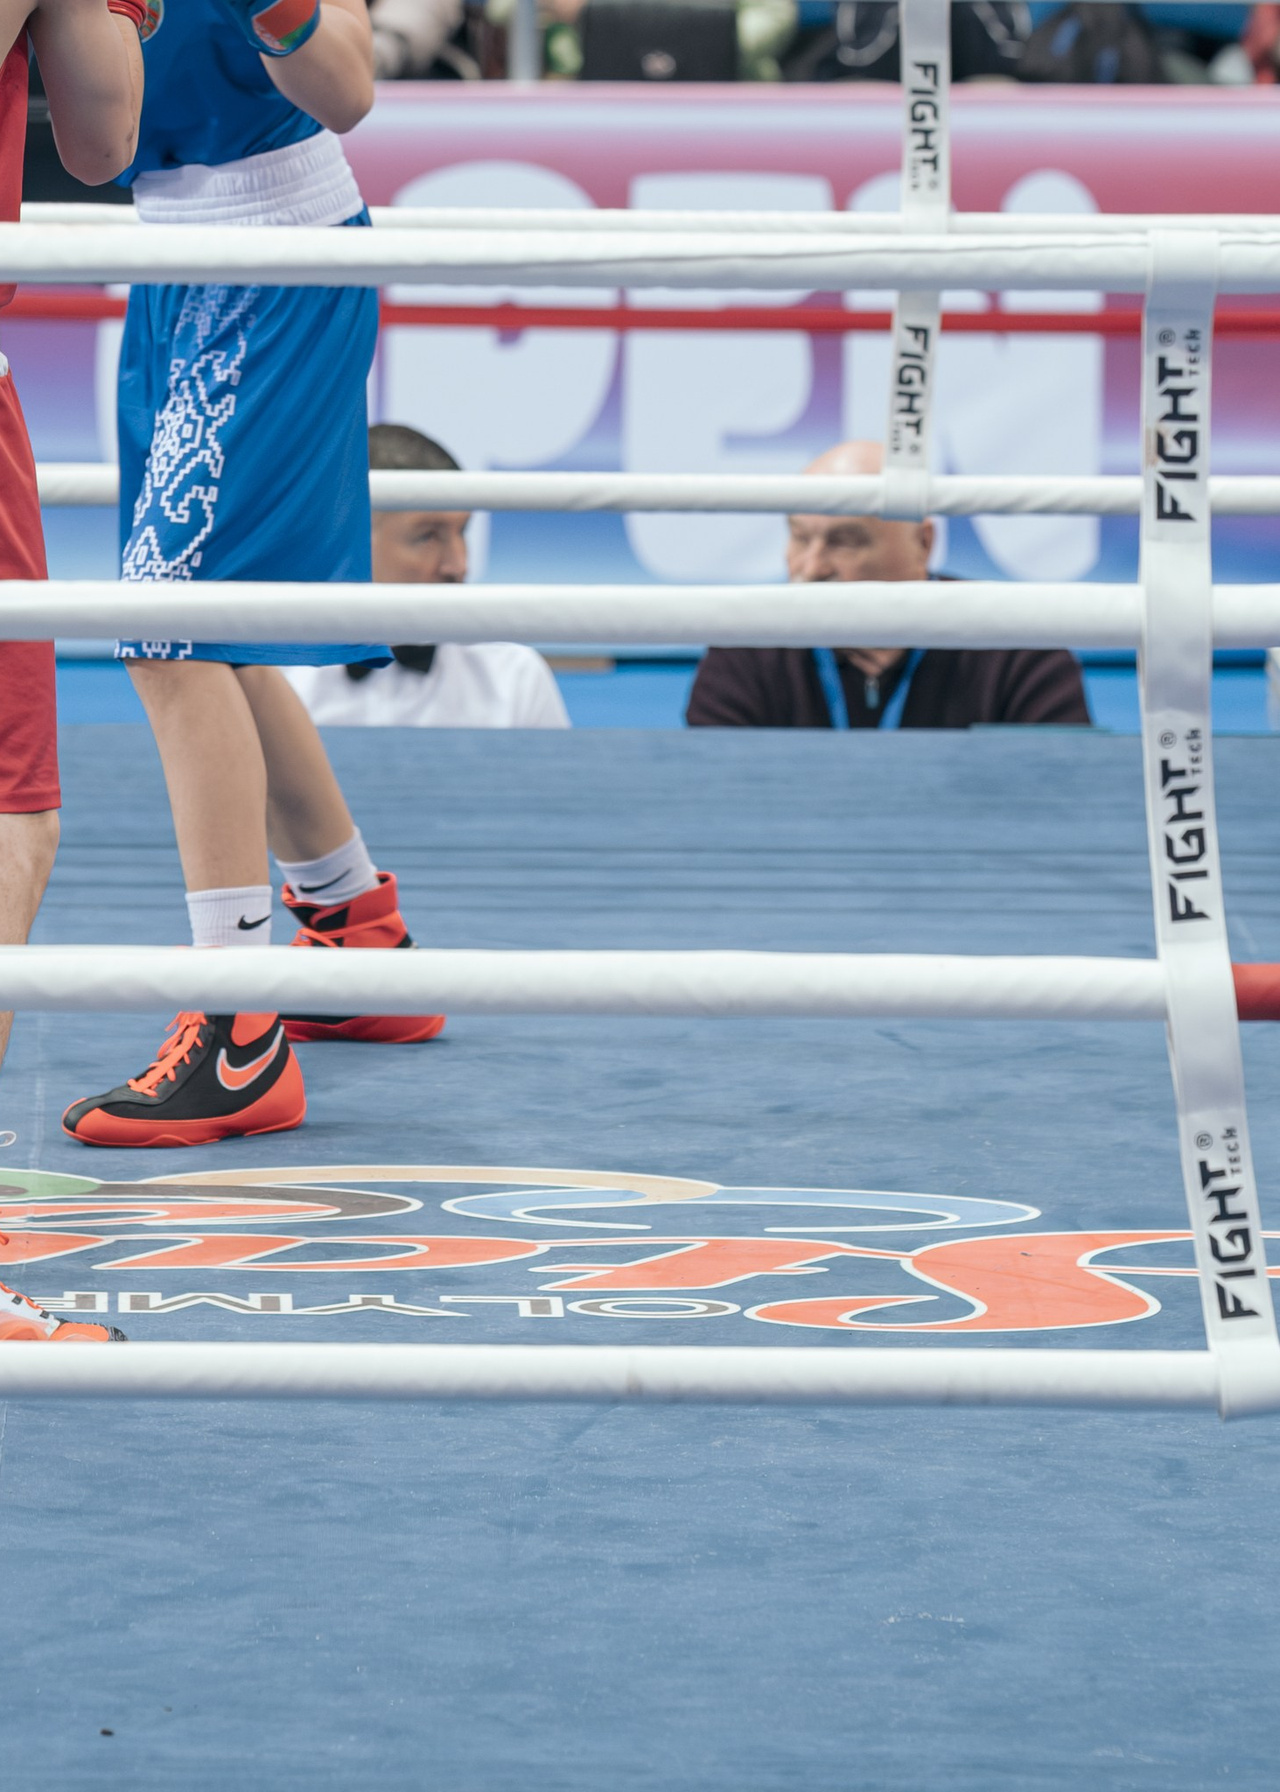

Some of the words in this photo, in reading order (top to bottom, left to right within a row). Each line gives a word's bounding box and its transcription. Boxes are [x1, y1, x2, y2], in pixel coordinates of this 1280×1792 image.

[911, 62, 938, 172] FIGHT
[897, 326, 929, 436] FIGHT
[1156, 356, 1198, 522] FIGHT
[1161, 759, 1211, 922] FIGHT
[1199, 1161, 1261, 1320] FIGHT
